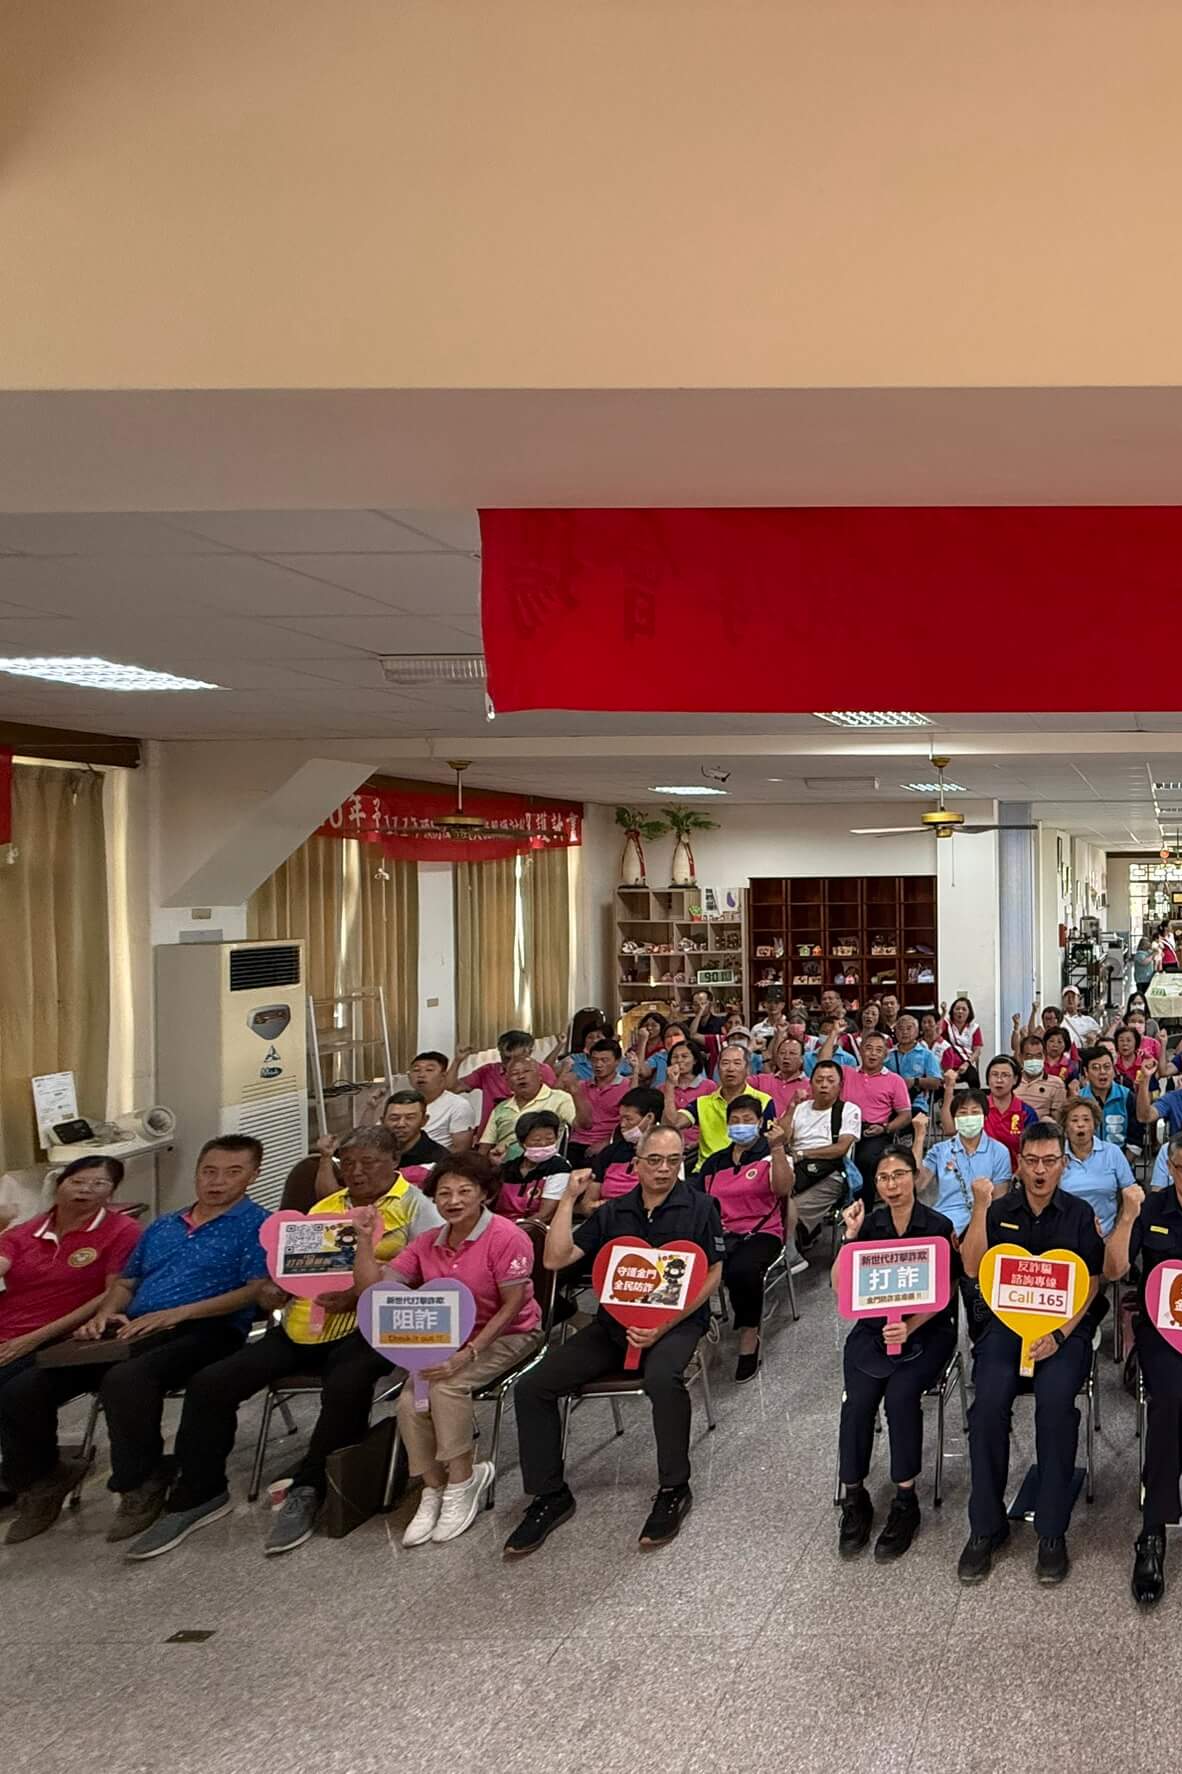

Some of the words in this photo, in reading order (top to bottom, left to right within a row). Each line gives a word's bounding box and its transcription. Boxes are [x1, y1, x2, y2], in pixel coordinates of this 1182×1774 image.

[617, 1266, 657, 1279] 守護金門
[1018, 1261, 1052, 1274] 反詐騙
[869, 1266, 919, 1291] 打詐
[1011, 1274, 1057, 1288] 諮詢專線
[614, 1280, 655, 1292] 全民防詐
[1008, 1290, 1034, 1304] Call
[1038, 1293, 1064, 1307] 165
[393, 1309, 438, 1330] 阻詐
